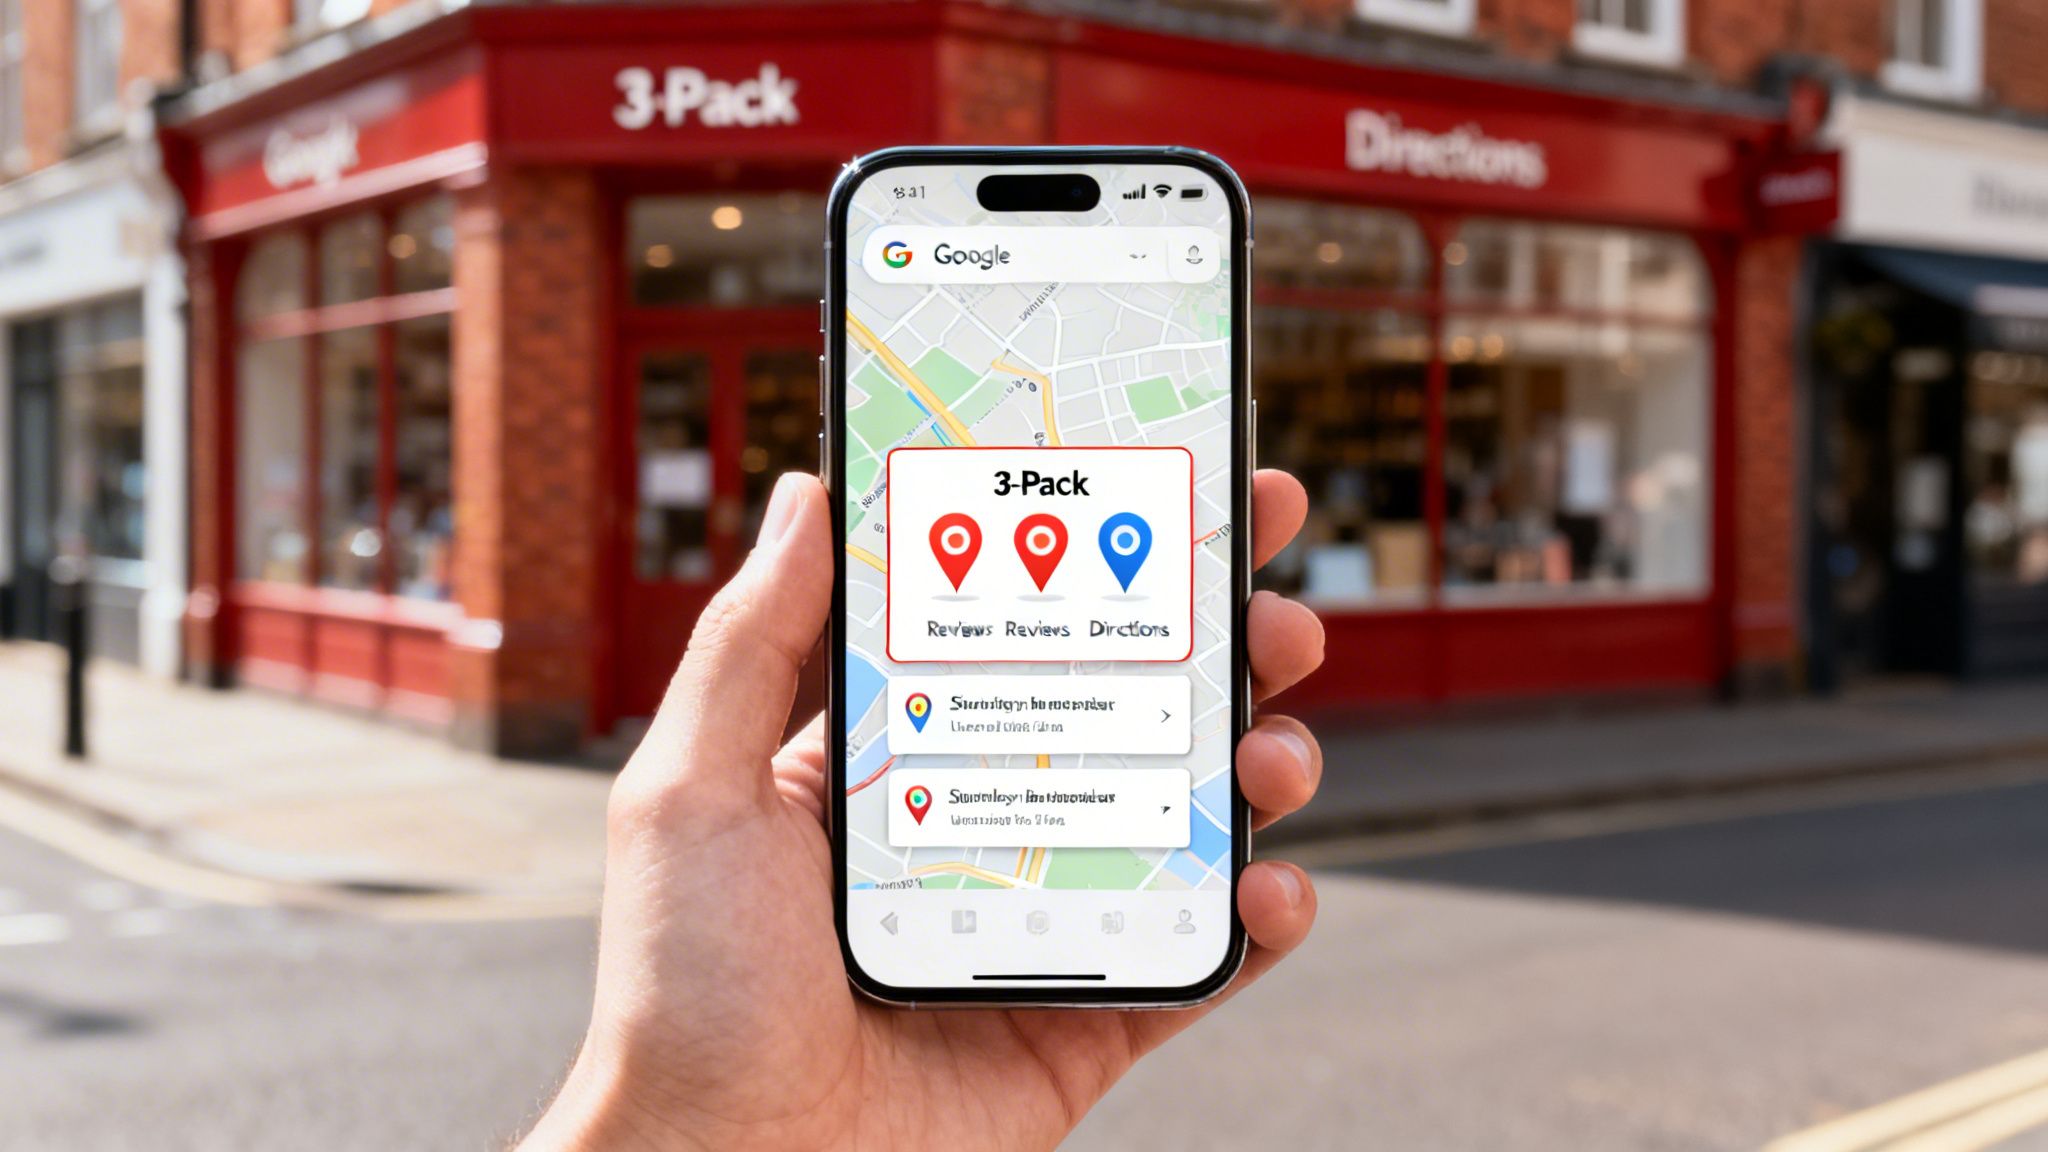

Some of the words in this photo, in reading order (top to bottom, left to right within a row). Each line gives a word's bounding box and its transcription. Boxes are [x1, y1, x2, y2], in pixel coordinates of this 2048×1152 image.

[614, 63, 799, 129] 3-Pack
[934, 243, 1011, 270] Google
[994, 469, 1090, 496] 3-Pack
